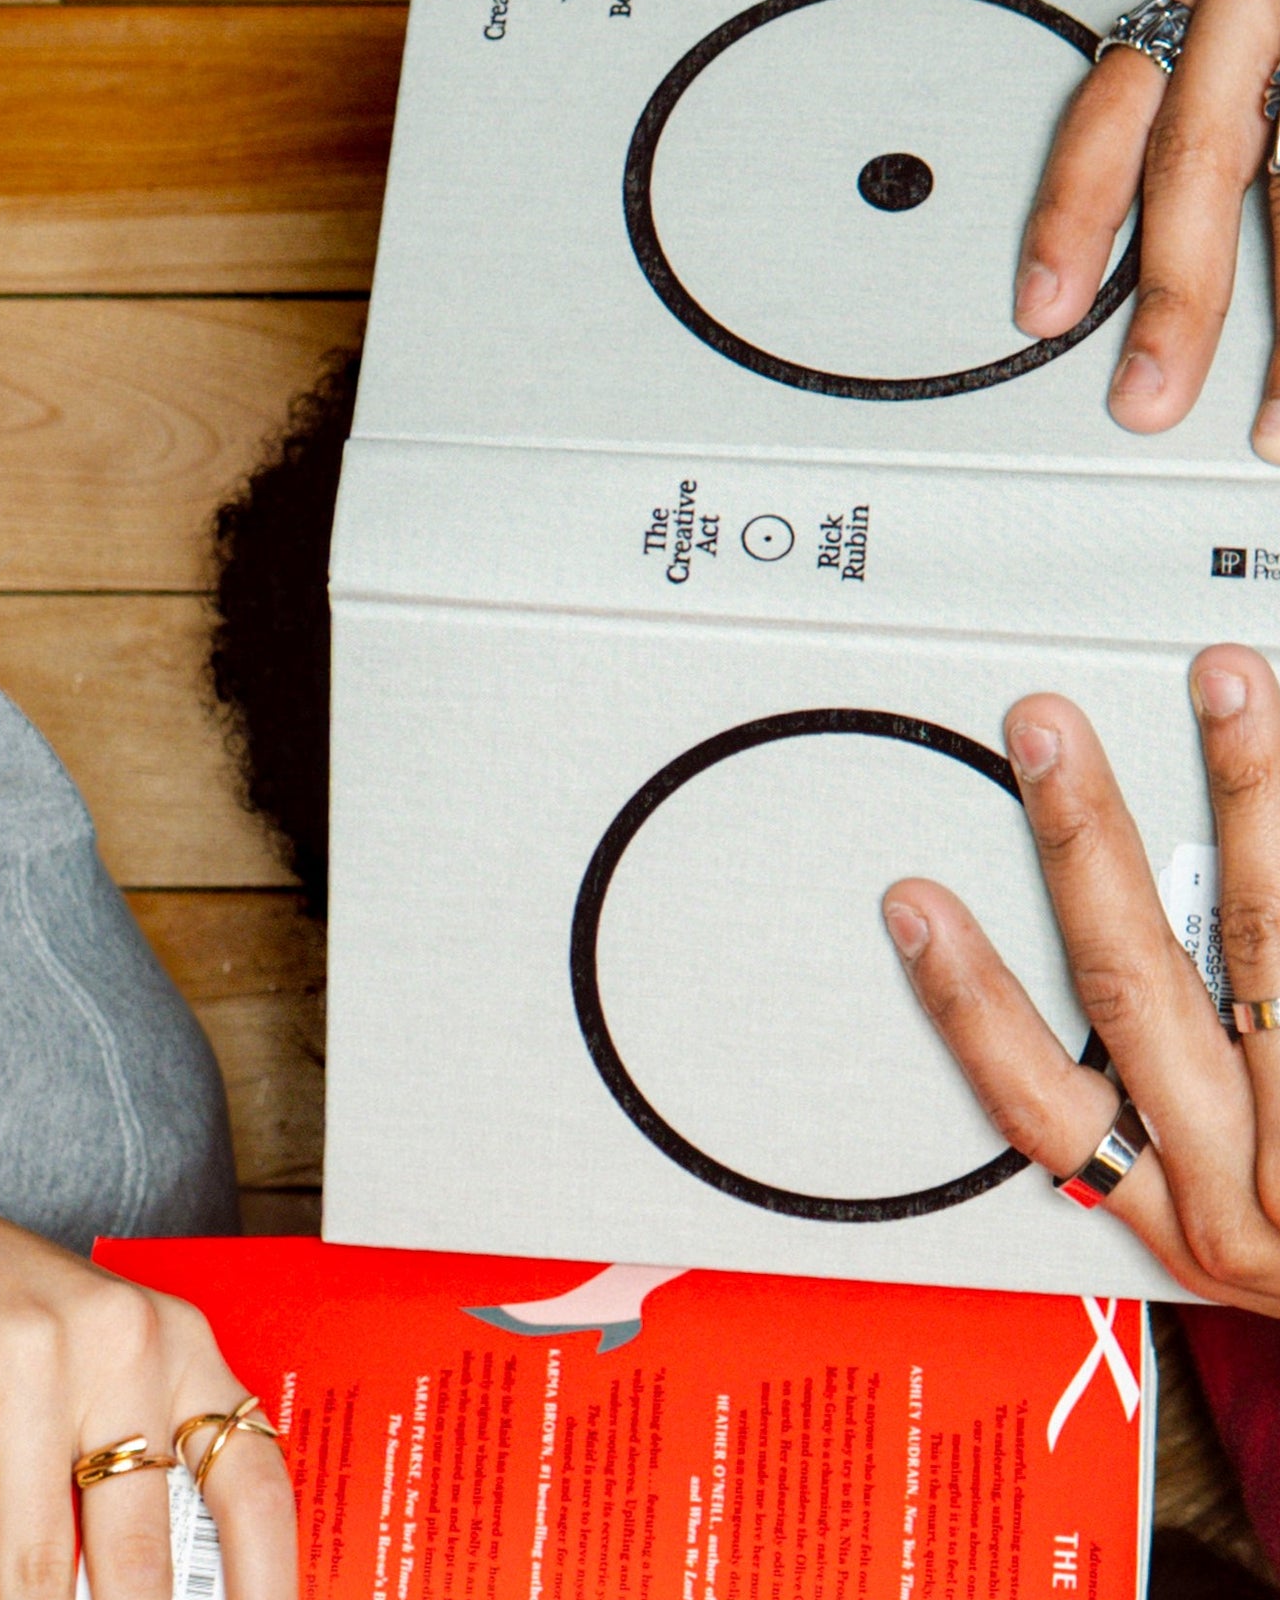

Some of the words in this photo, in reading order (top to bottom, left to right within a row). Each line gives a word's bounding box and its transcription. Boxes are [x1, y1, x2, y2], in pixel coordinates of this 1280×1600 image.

[643, 507, 670, 555] The
[666, 479, 697, 584] Creative
[695, 514, 720, 557] Act
[817, 514, 844, 570] Rick
[841, 504, 870, 583] Rubin
[544, 1350, 562, 1398] KARMA
[906, 1365, 923, 1421] ASHLEY
[537, 1402, 559, 1461] BROWN,
[539, 1464, 552, 1480] #1
[903, 1427, 920, 1499] AUDRAIN,
[531, 1483, 550, 1558] bestselling
[902, 1505, 917, 1534] New
[900, 1539, 915, 1570] York
[1051, 1532, 1079, 1589] THE
